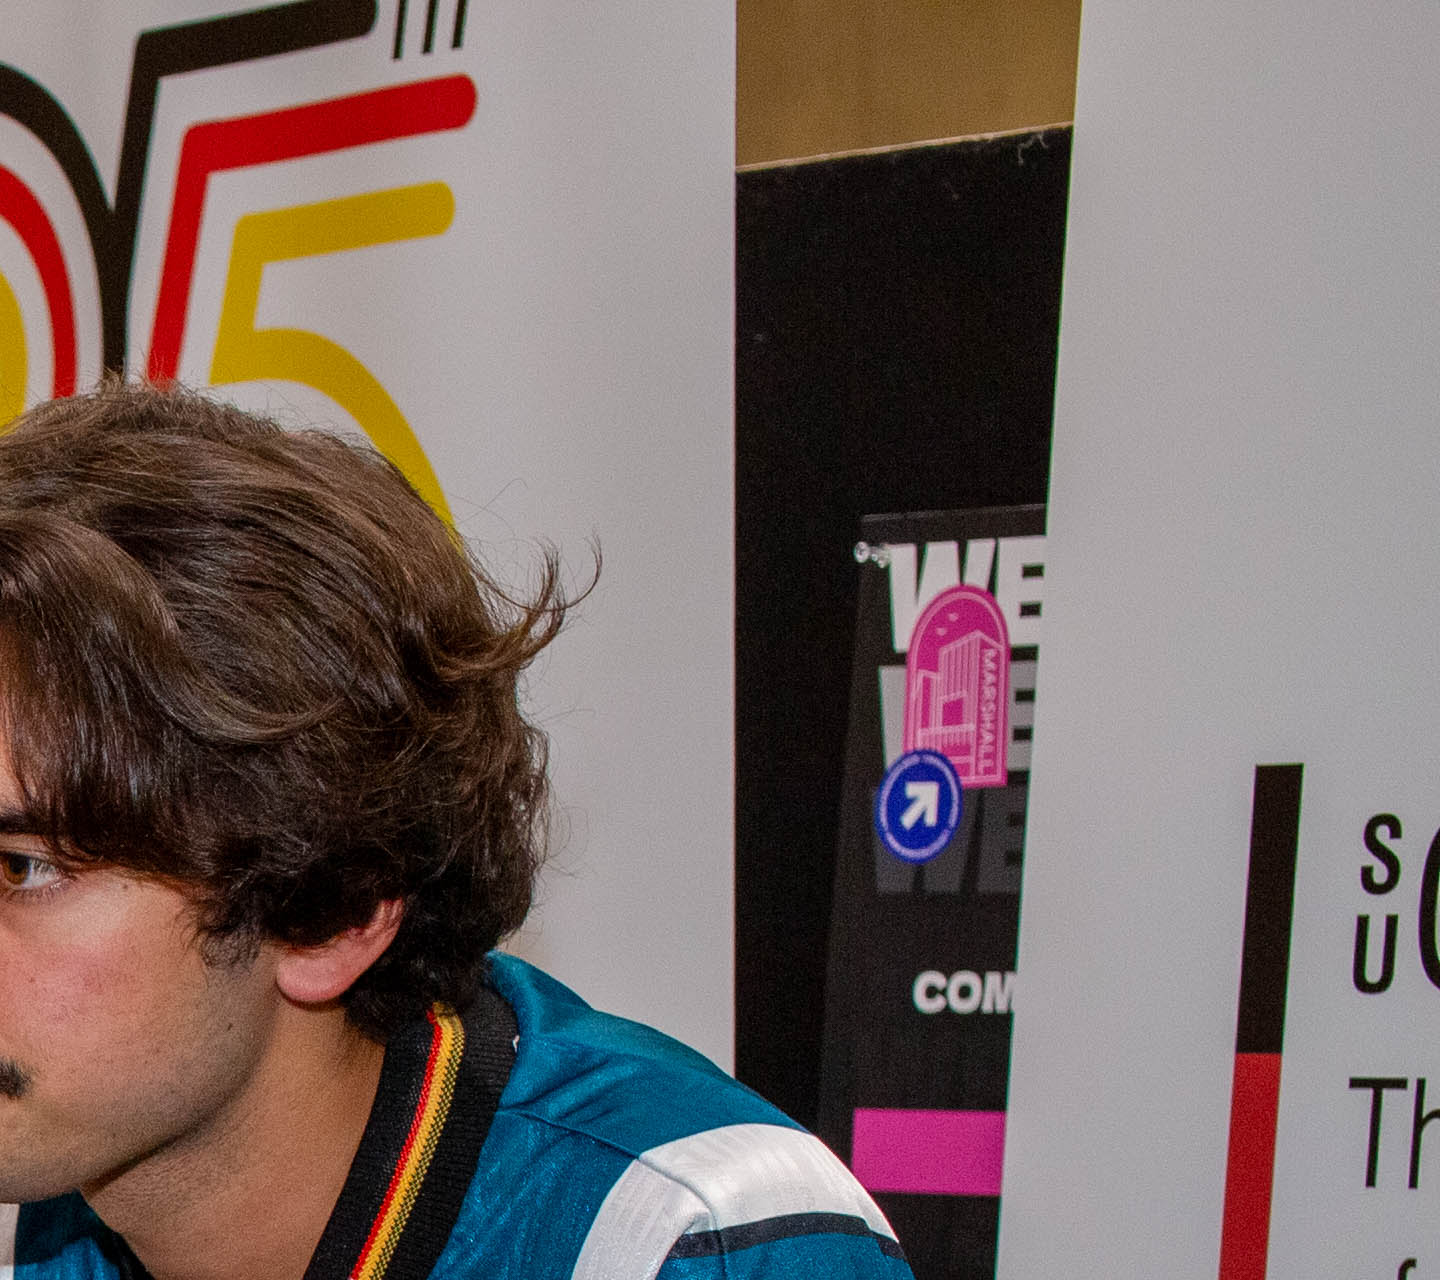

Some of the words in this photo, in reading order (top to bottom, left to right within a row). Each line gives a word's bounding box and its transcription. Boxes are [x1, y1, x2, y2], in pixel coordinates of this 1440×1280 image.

[981, 646, 999, 778] MARSHALL
[912, 970, 1018, 1015] COM
[1348, 1077, 1440, 1190] Th
